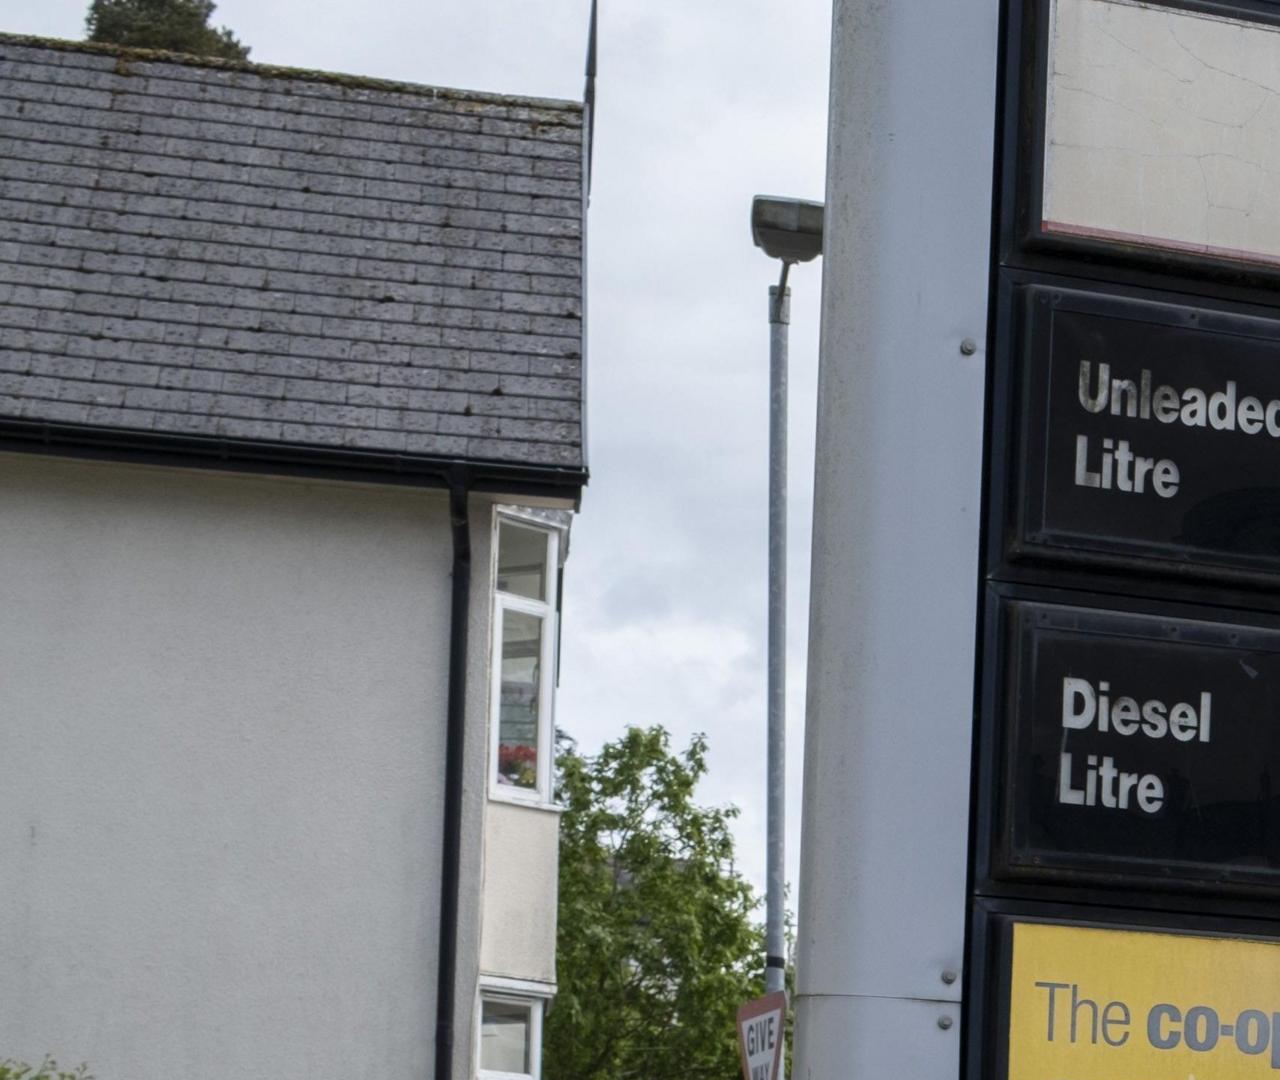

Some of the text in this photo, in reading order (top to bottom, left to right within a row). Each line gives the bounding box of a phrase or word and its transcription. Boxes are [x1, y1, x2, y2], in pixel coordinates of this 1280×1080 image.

[1074, 435, 1181, 499] Litre
[1062, 677, 1211, 744] Diesel
[1059, 751, 1164, 814] Litre
[747, 1017, 775, 1057] GIVE
[1034, 981, 1131, 1048] The
